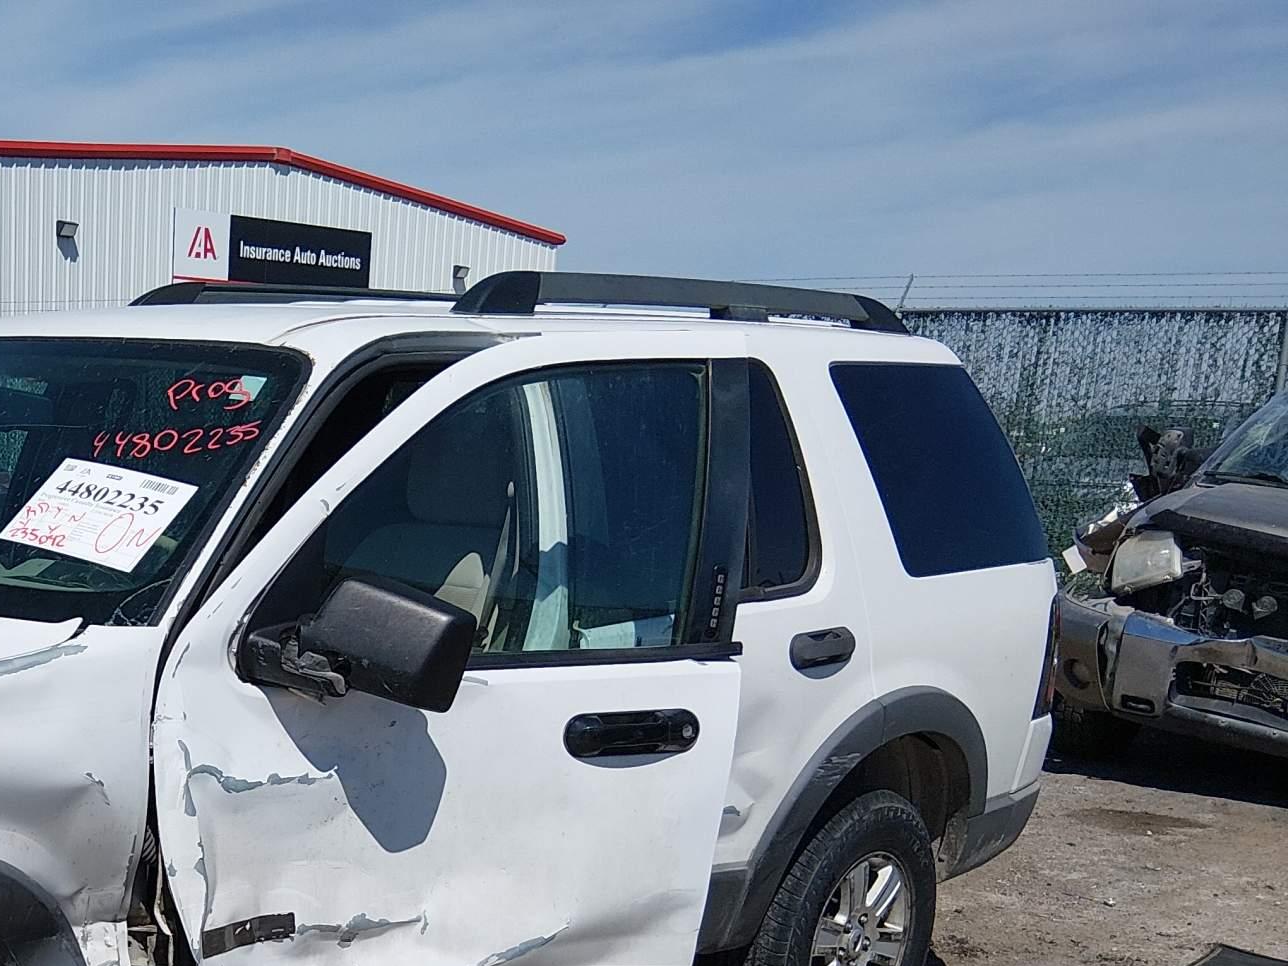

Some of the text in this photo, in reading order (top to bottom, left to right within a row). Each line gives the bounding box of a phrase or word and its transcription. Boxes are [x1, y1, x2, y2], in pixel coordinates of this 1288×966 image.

[239, 240, 361, 270] Insurance Auto Auctions
[93, 421, 262, 458] 44802235
[55, 479, 165, 516] 44802235
